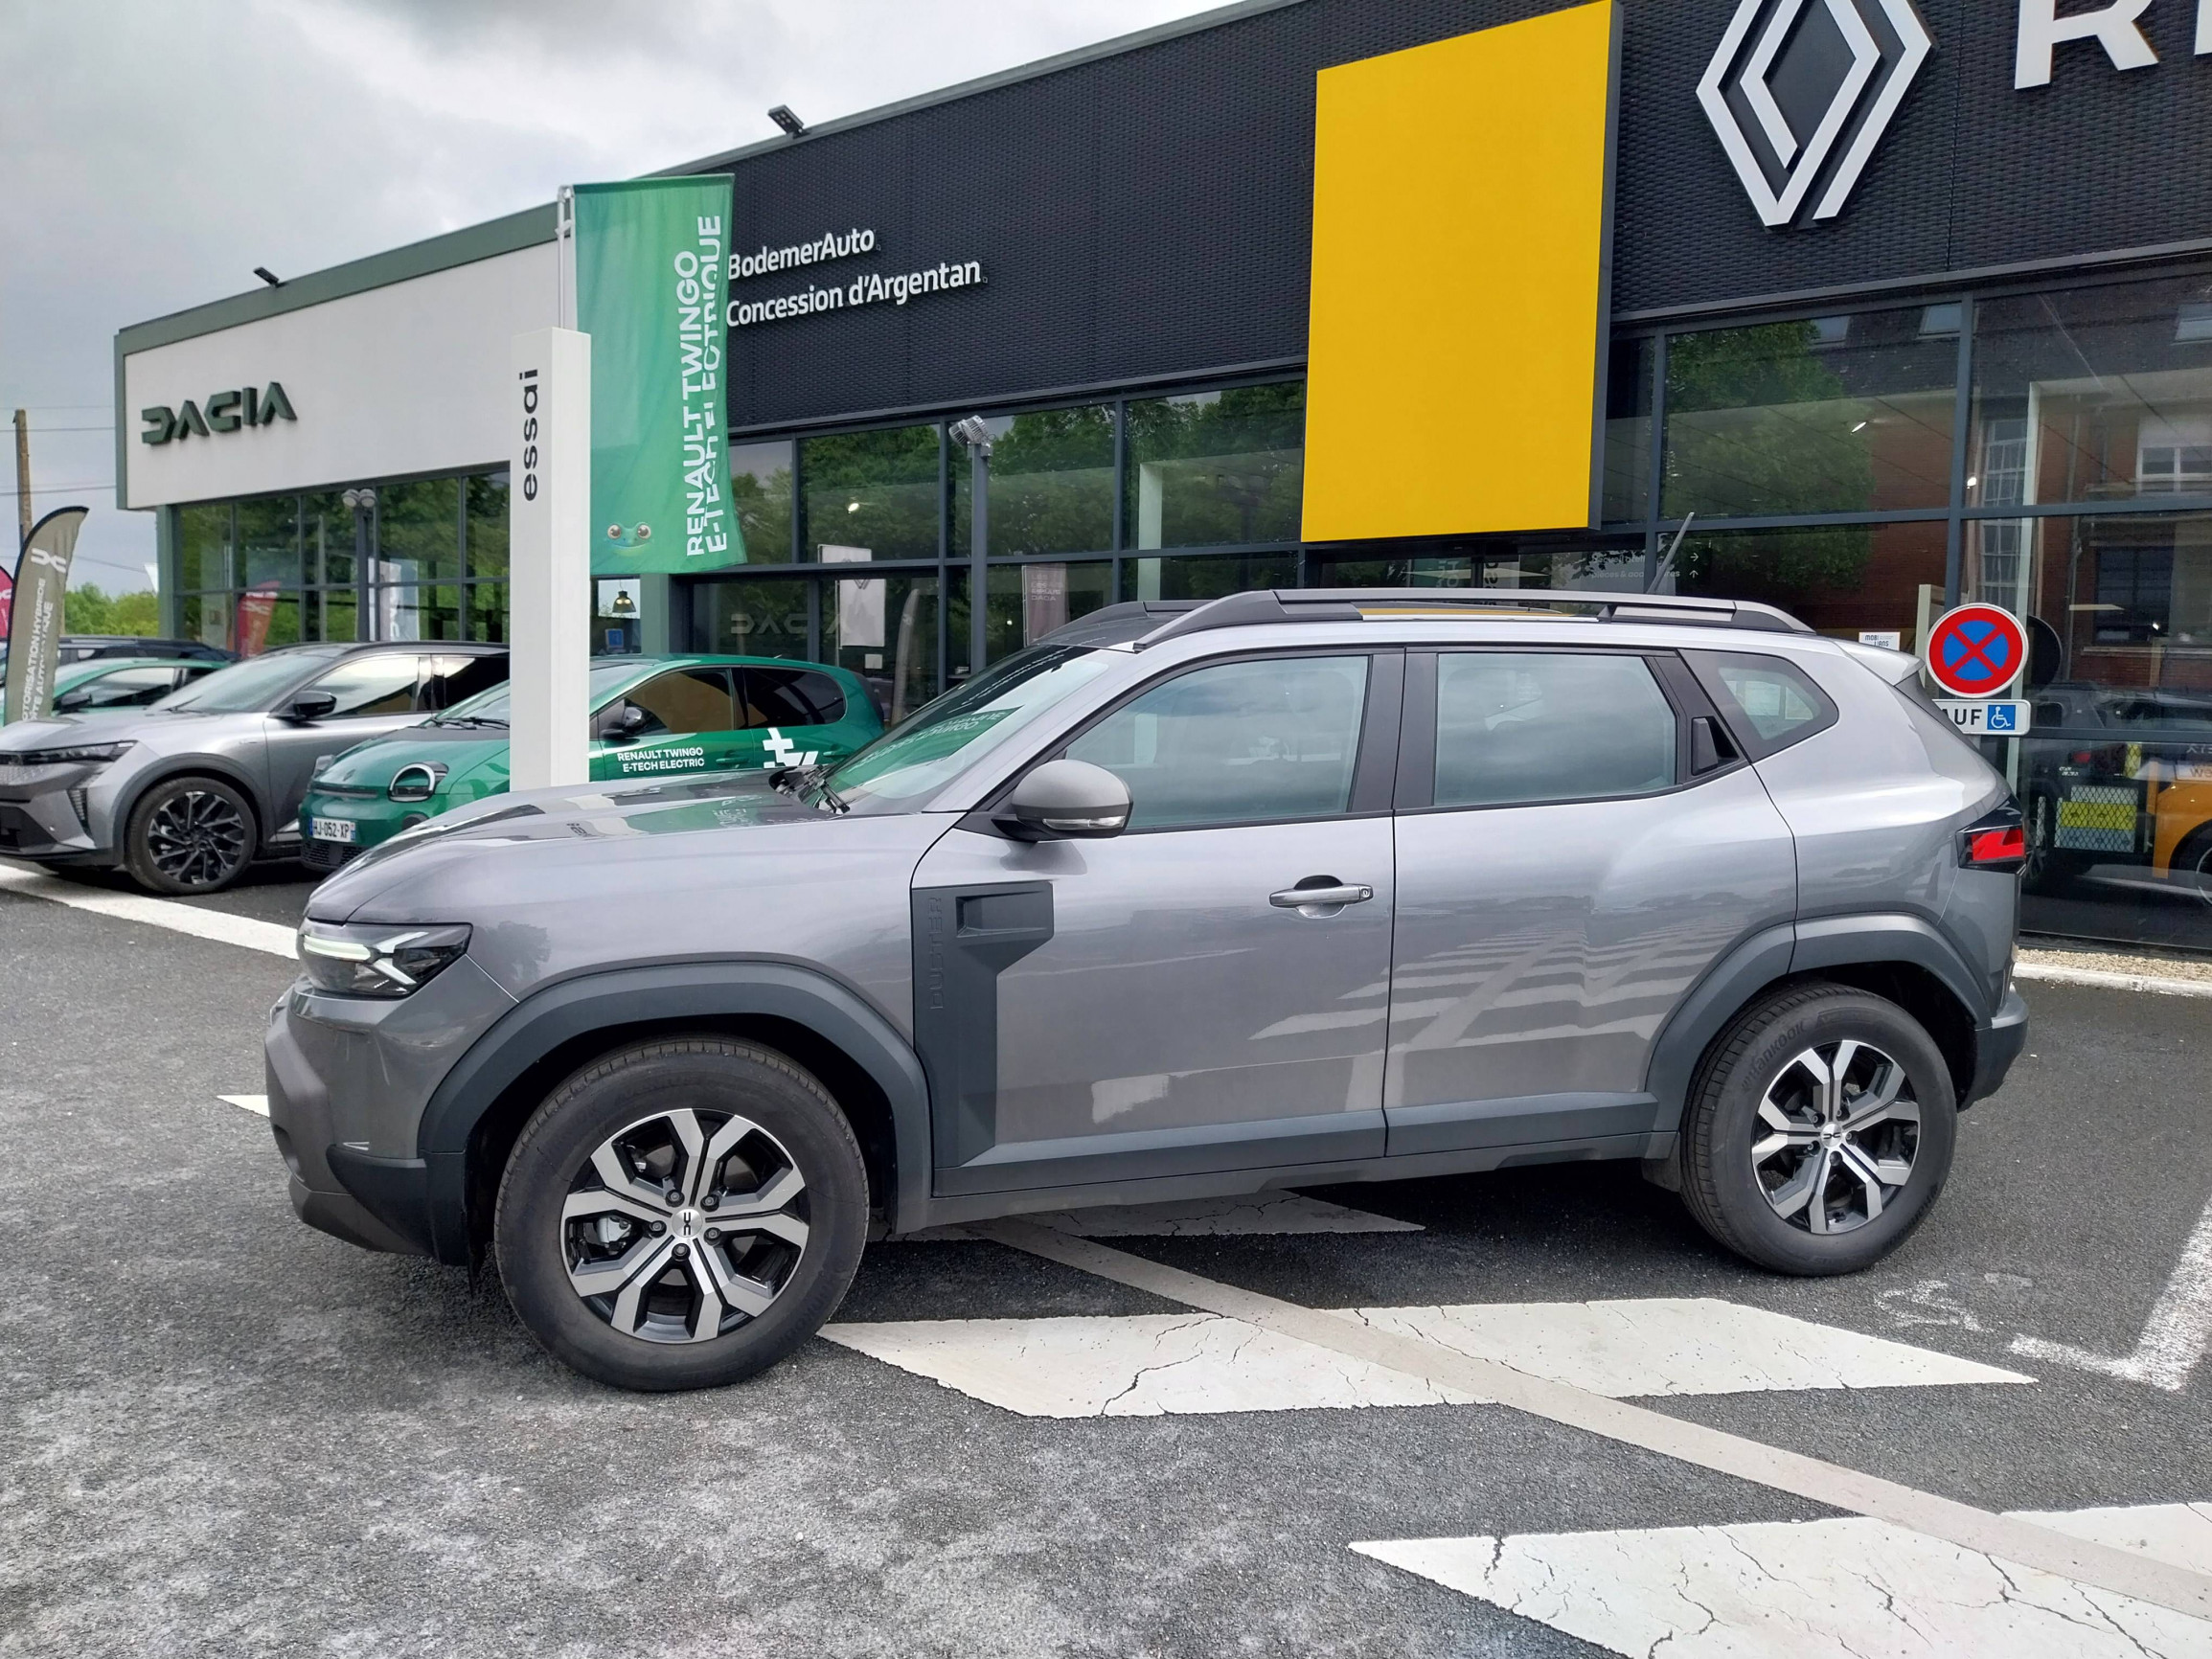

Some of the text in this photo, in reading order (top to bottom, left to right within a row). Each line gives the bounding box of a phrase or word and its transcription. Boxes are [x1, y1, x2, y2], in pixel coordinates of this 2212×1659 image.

[727, 228, 875, 280] BodemerAuto
[726, 261, 981, 327] Concession d'Argentan
[141, 381, 297, 443] DACIA
[518, 369, 538, 502] essai
[673, 251, 706, 556] RENAULT TWINGO
[21, 578, 46, 721] OTORISATION HYBRIDE
[731, 614, 851, 635] DACA
[617, 747, 703, 761] RENAULT TWINGO
[623, 758, 705, 773] E-TECH ELECTRIC
[928, 897, 945, 1010] DUSTER
